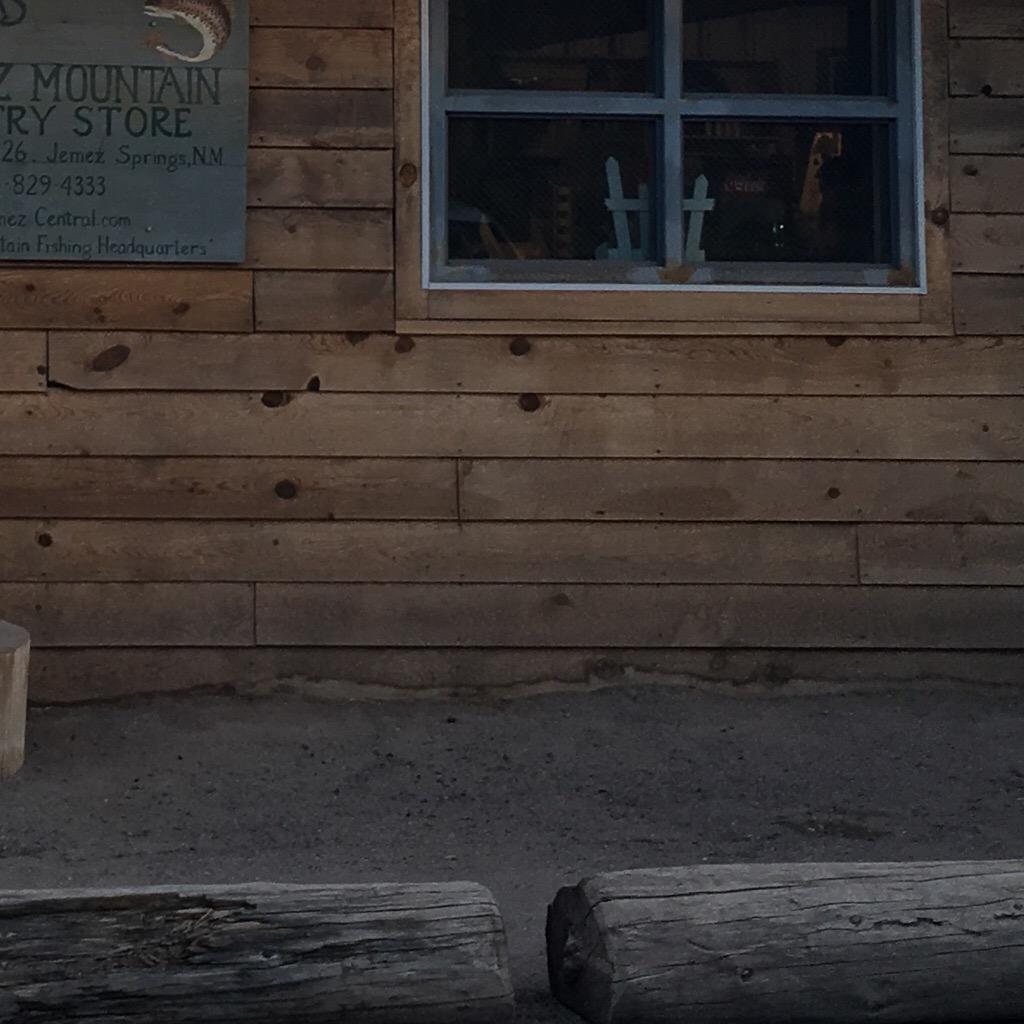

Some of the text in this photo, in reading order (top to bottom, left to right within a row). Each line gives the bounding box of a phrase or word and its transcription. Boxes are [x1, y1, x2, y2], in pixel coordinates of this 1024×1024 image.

[30, 63, 222, 105] MOUNTAIN
[72, 106, 193, 138] STORE
[46, 141, 106, 164] Jemez
[36, 234, 92, 259] Fishing
